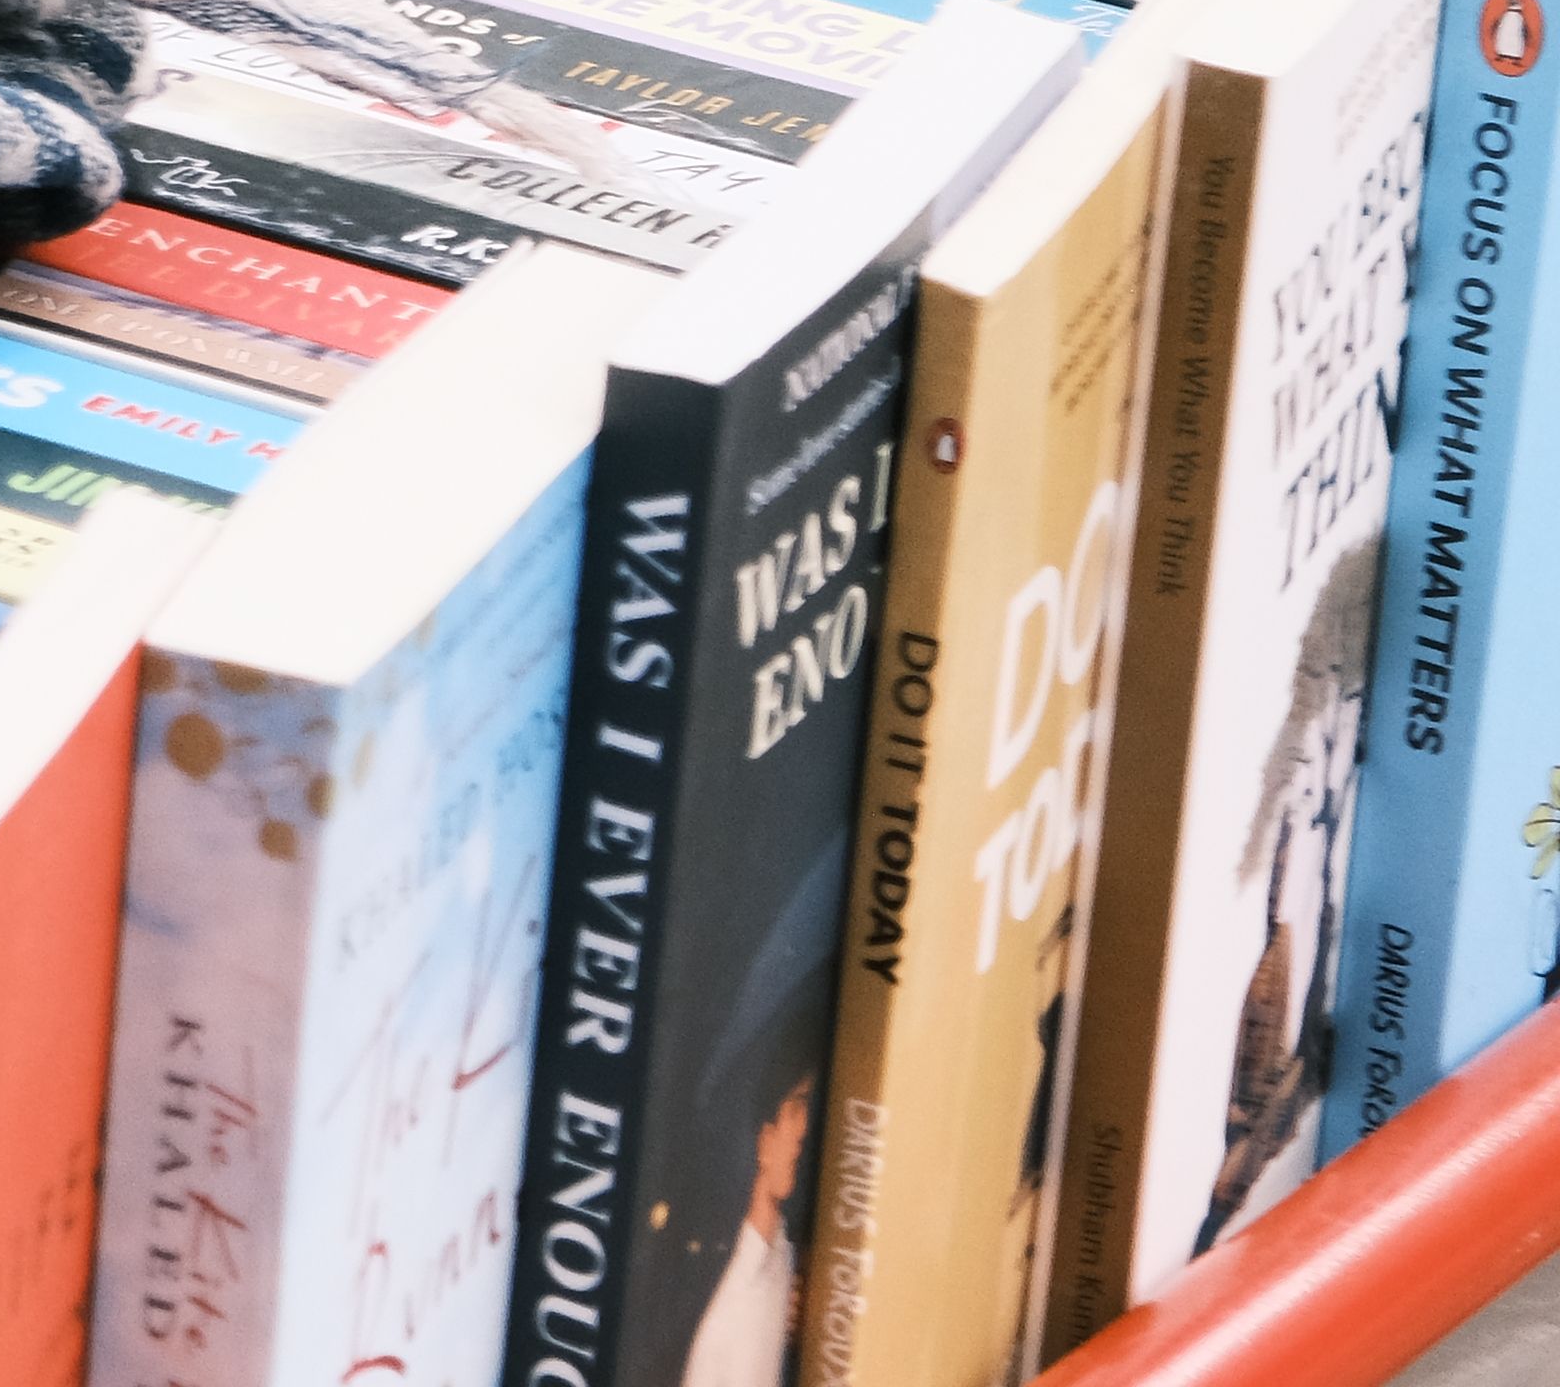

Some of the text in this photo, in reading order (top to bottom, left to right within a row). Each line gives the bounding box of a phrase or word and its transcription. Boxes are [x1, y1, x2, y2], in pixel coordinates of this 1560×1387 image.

[444, 156, 692, 235] COLLEEN
[557, 56, 737, 118] TAYLOR
[1404, 91, 1520, 760] FOCUS ON WHAT MATTERS
[563, 489, 694, 1058] WAS EVER
[859, 629, 939, 987] DO TODAY
